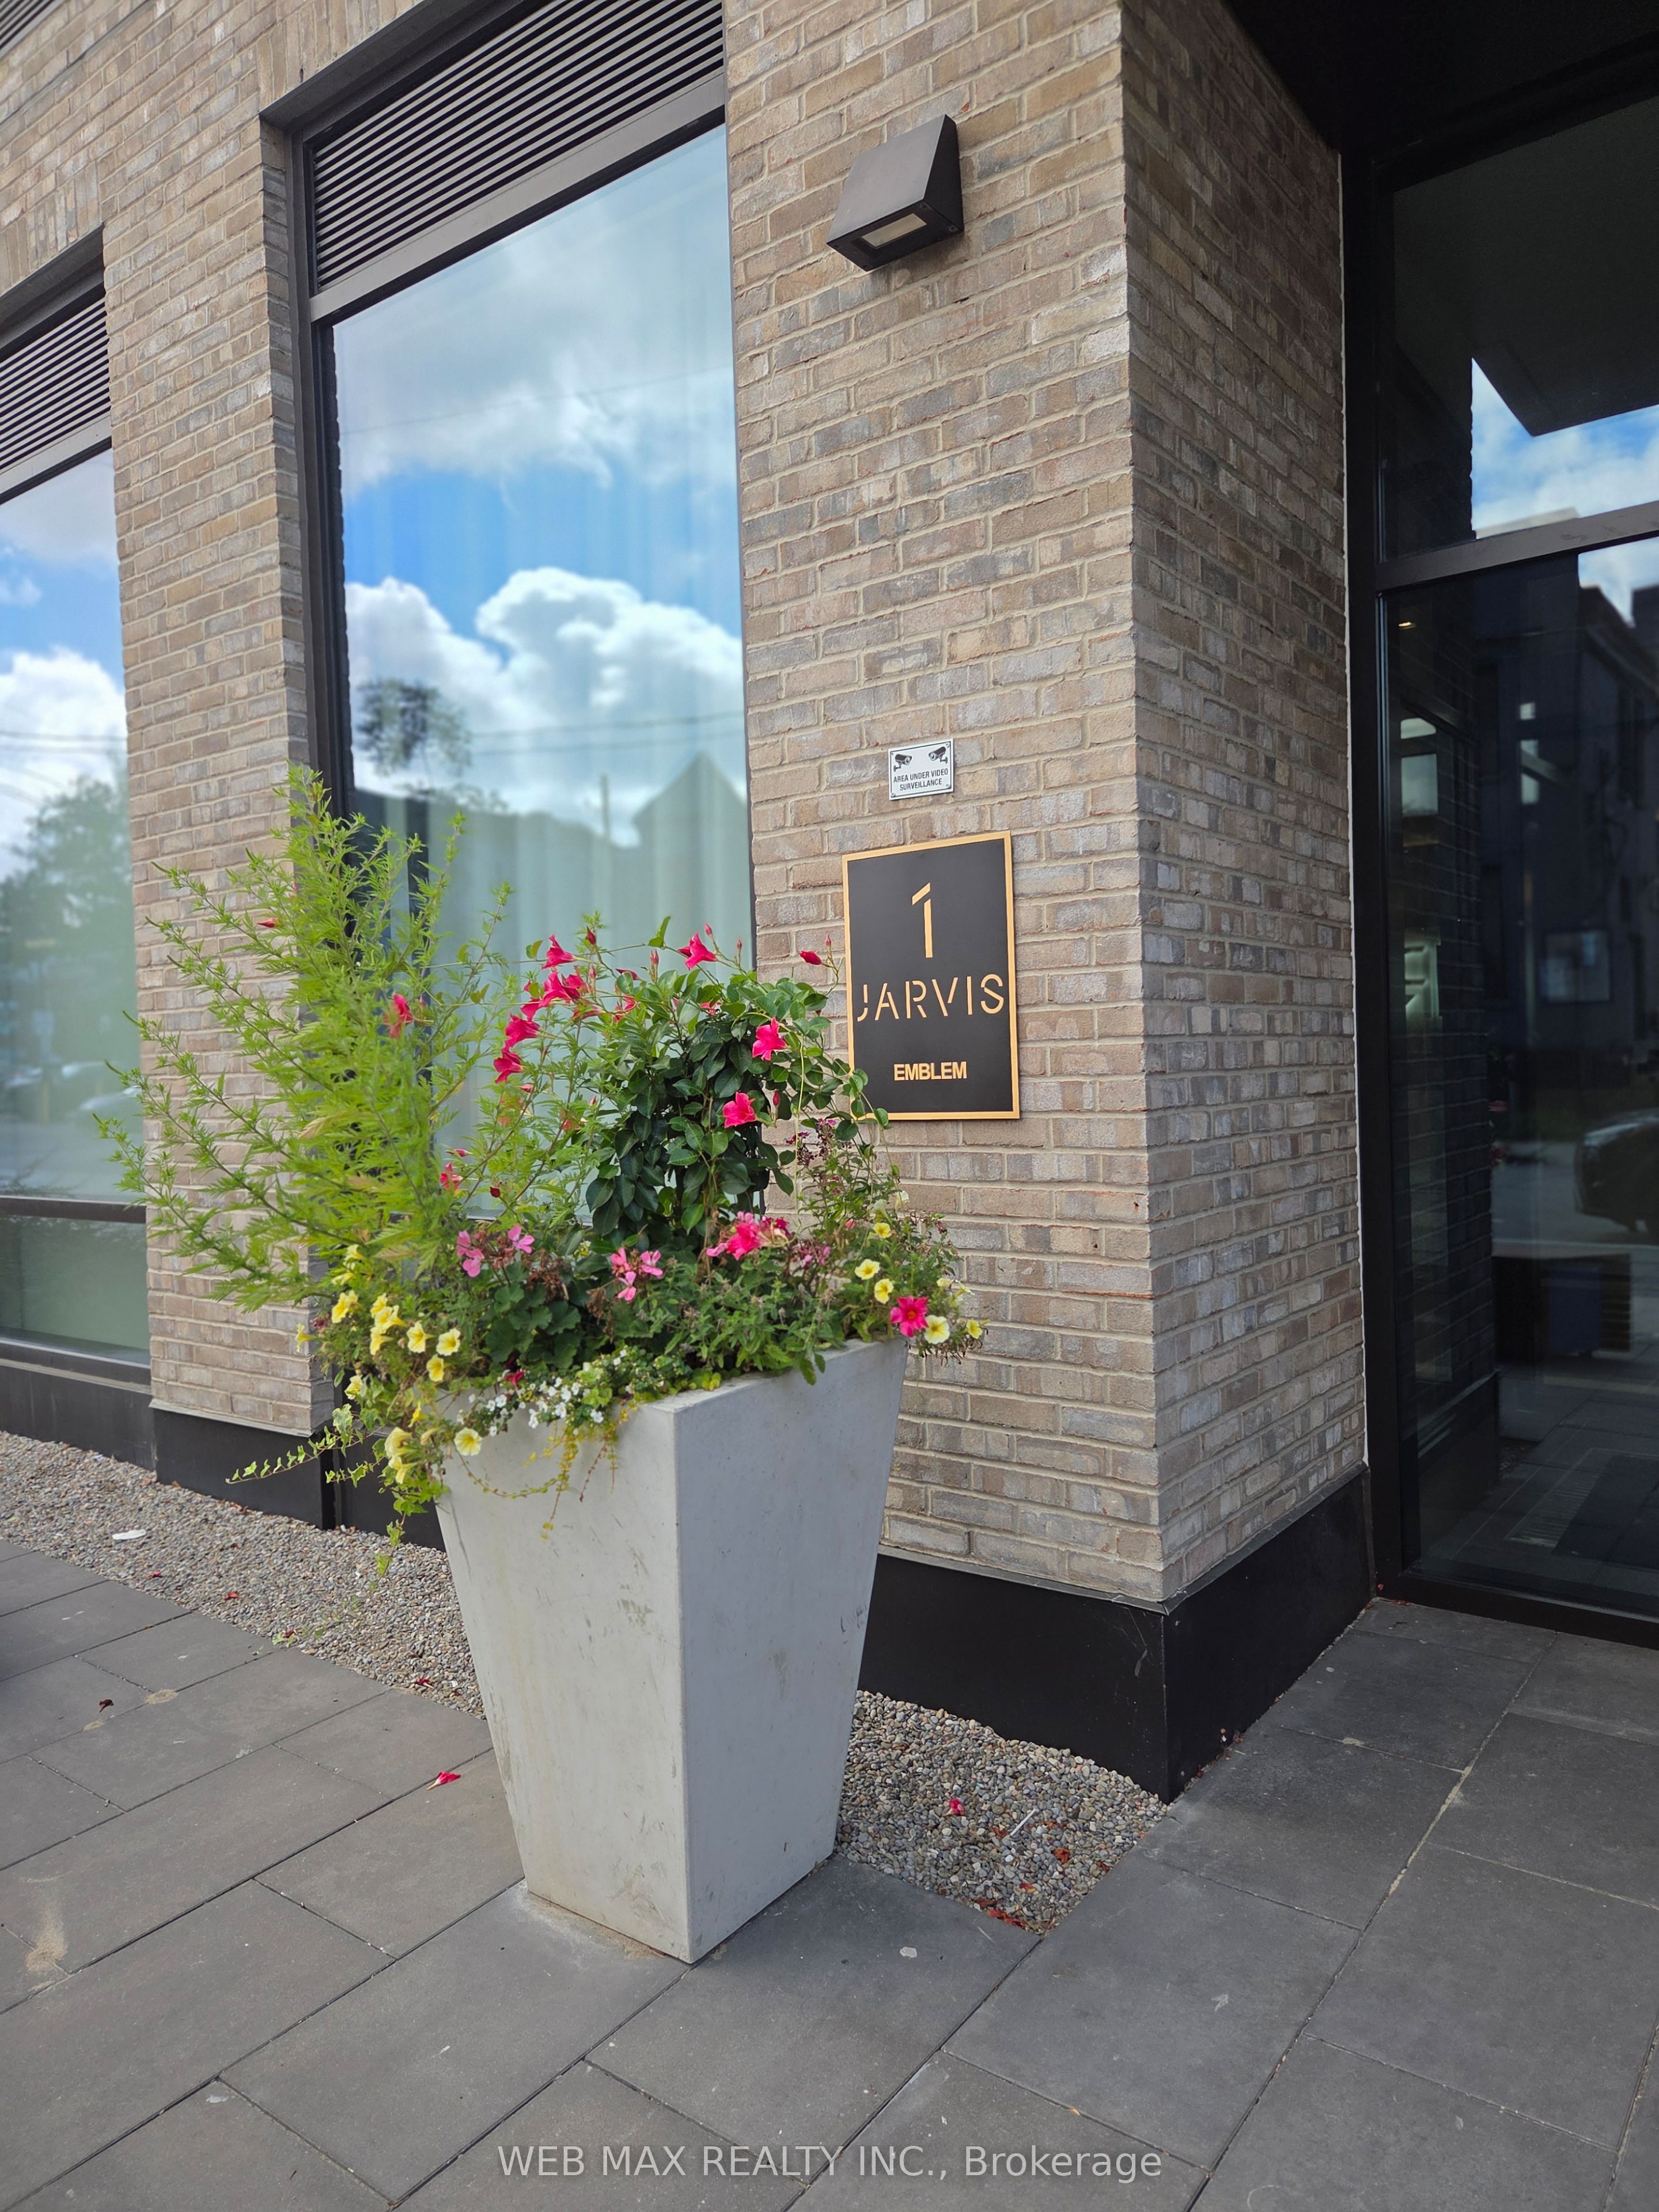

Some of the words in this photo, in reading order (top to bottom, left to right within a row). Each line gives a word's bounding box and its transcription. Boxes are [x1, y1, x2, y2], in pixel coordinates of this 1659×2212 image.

[893, 775, 908, 783] AREA
[910, 771, 929, 781] UNDER
[931, 768, 948, 777] VIDEO
[900, 778, 942, 791] SURVEILLANCE
[912, 882, 933, 959] 1
[857, 974, 1004, 1022] JARVIS
[893, 1061, 967, 1081] EMBLEM
